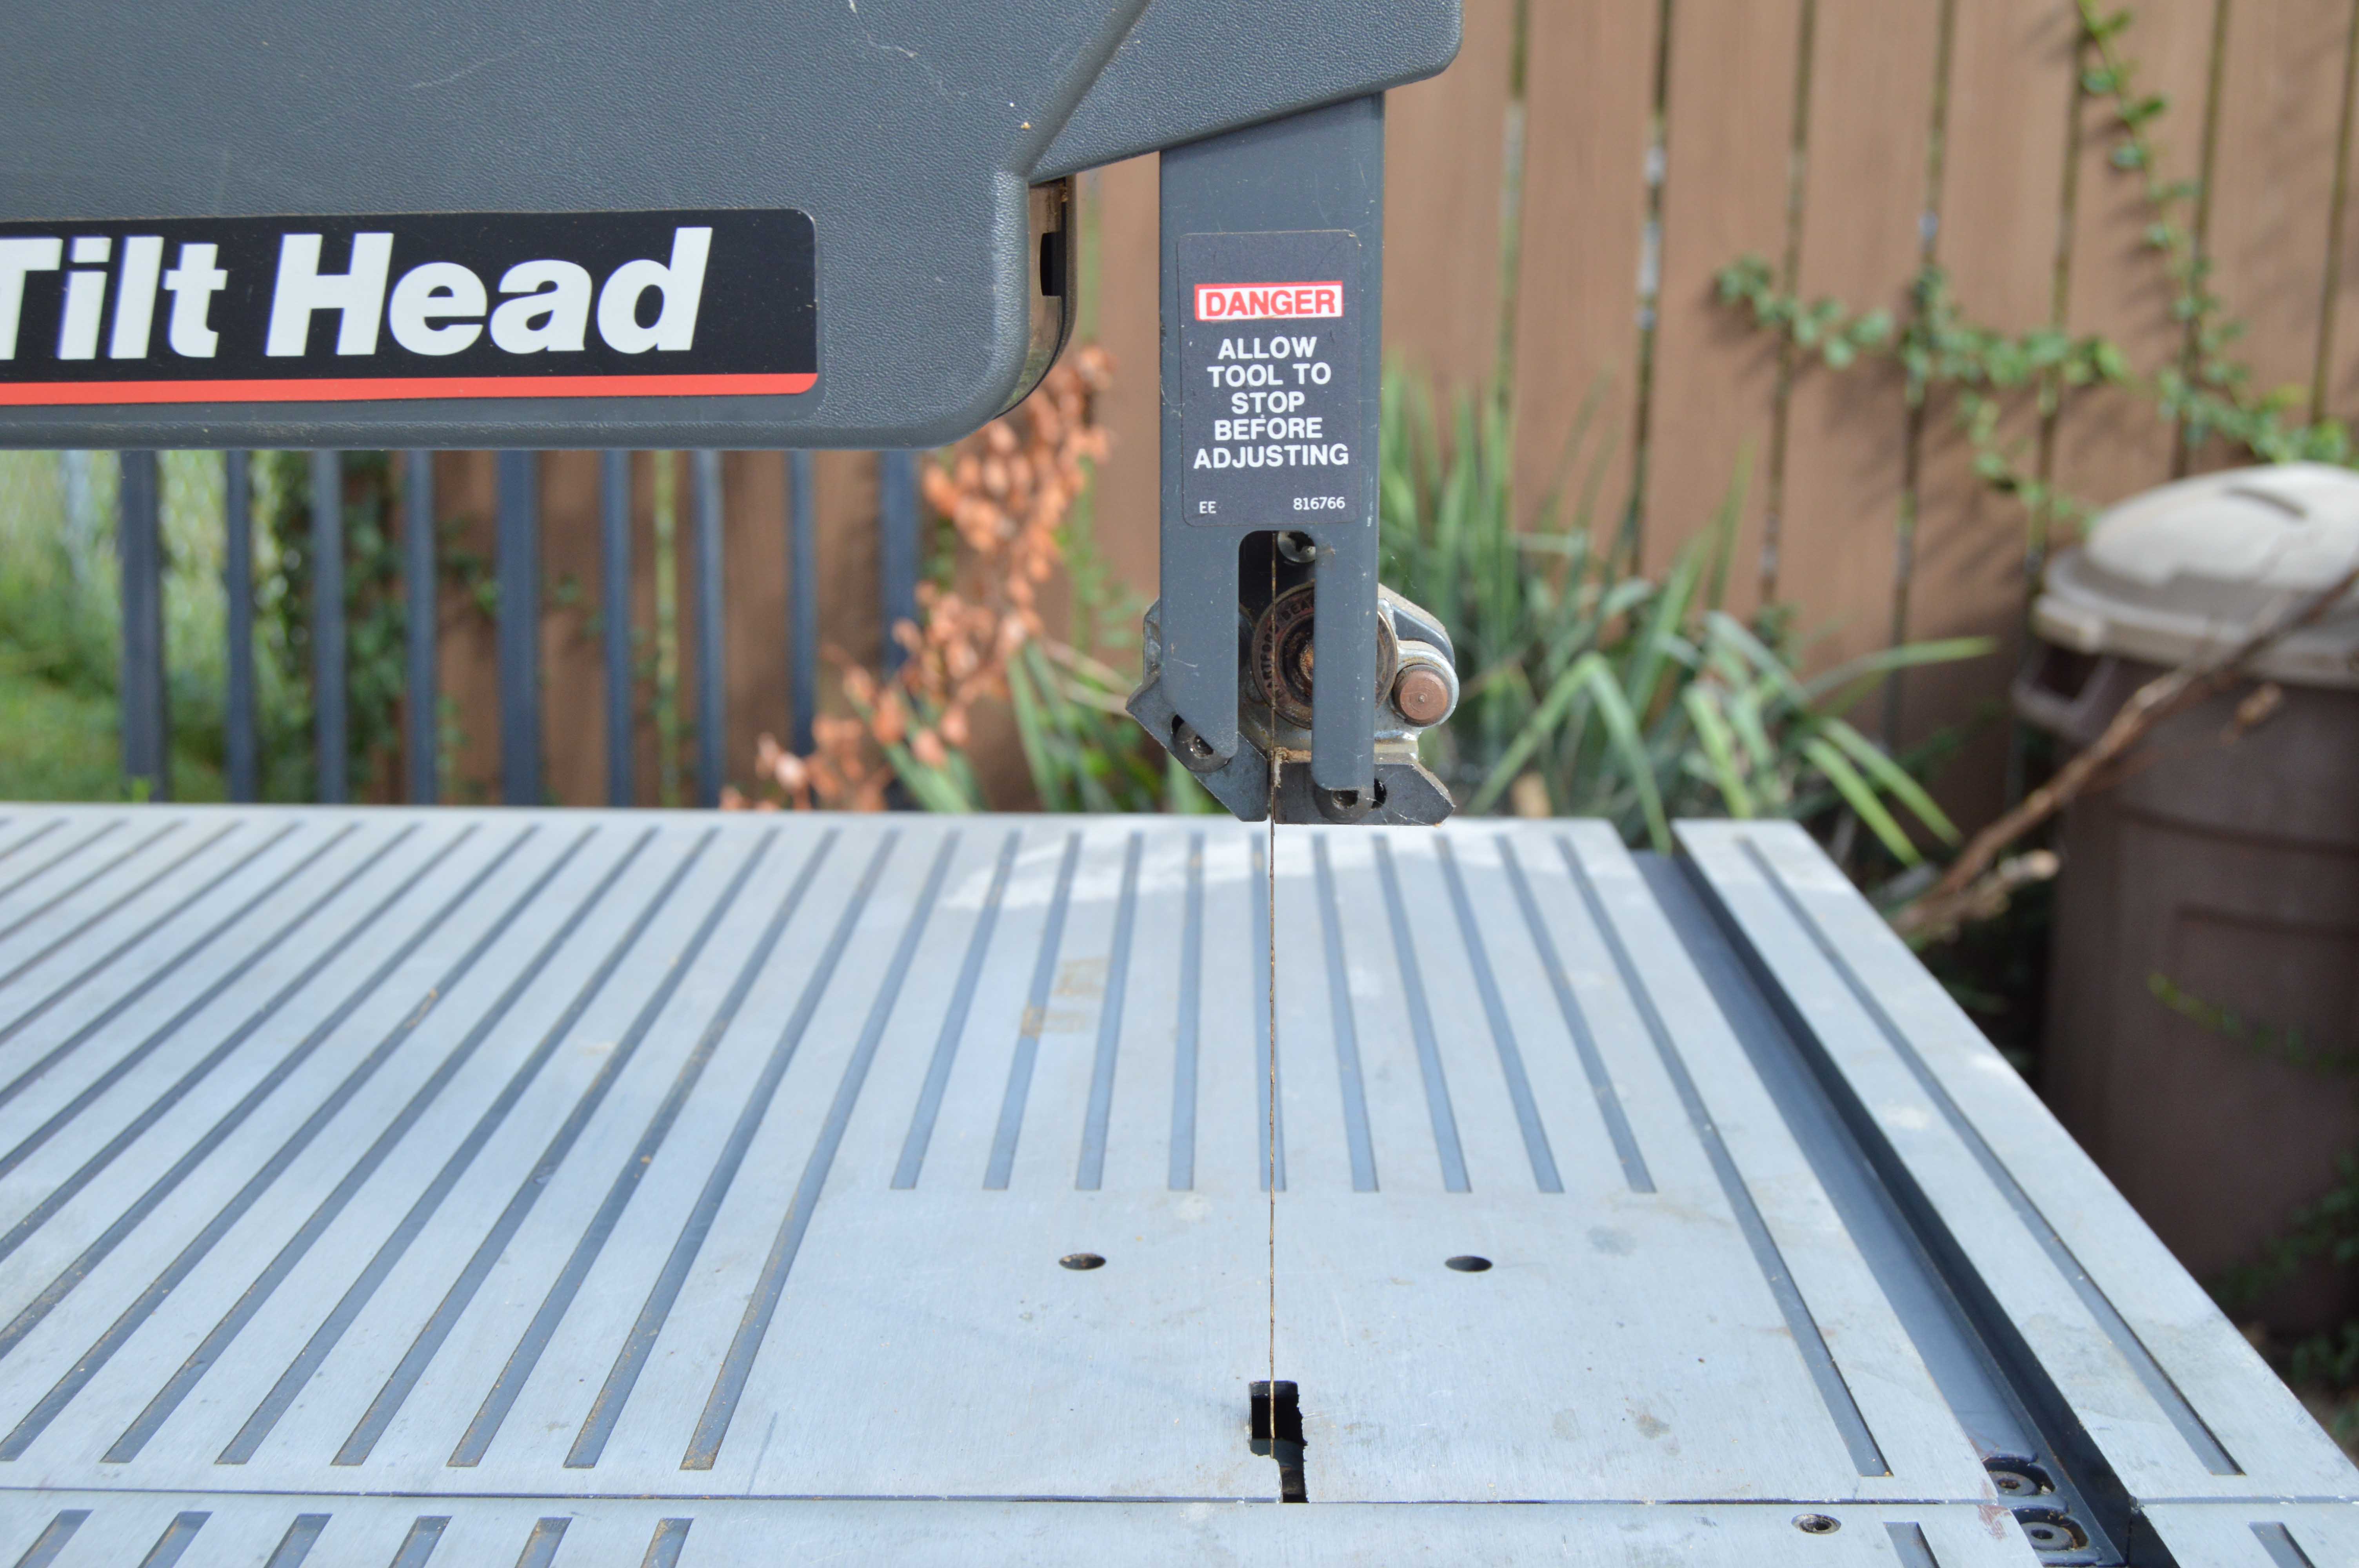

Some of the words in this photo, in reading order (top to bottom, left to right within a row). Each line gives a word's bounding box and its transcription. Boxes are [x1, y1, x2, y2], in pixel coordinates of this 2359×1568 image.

[267, 227, 712, 356] Head
[1205, 289, 1336, 316] DANGER
[1218, 336, 1317, 359] ALLOW
[1207, 364, 1283, 387] TOOL
[1292, 362, 1332, 385] TO
[1232, 391, 1305, 414] STOP
[1215, 417, 1323, 441] BEFORE
[1194, 443, 1349, 469] ADJUSTING
[1199, 501, 1217, 514] EE
[1293, 497, 1346, 510] 816766
